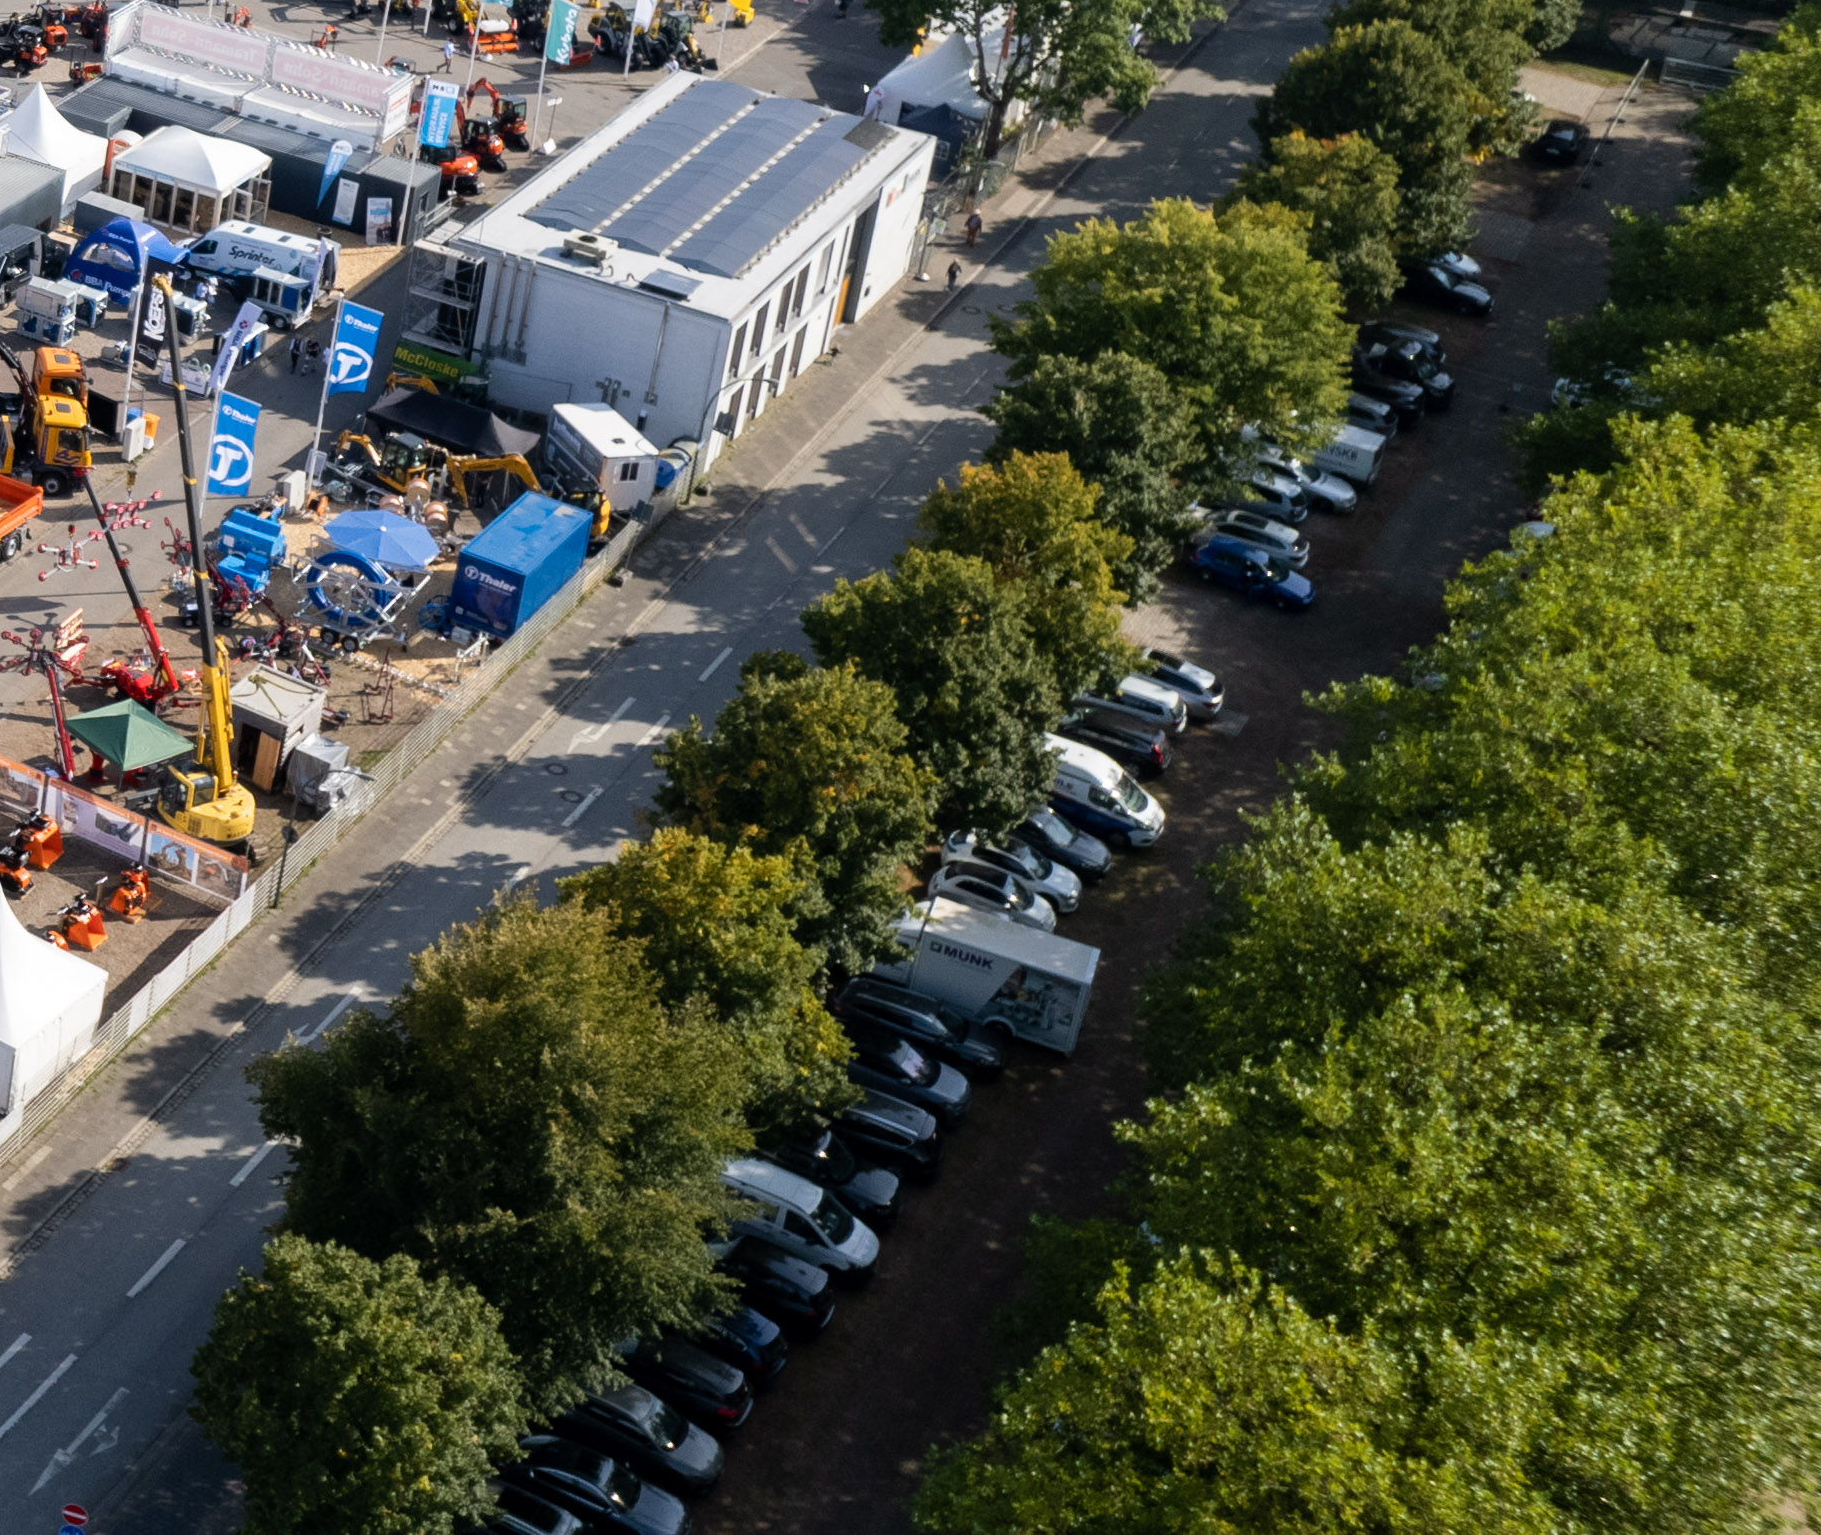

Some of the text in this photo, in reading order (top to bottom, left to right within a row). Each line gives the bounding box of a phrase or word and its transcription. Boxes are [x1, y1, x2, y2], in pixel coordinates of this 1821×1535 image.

[555, 7, 578, 65] Kubota
[228, 245, 276, 266] Sprinter
[353, 316, 379, 333] Thaler
[394, 346, 460, 378] McCloske
[232, 407, 257, 424] Thaler
[478, 571, 518, 592] Thaler
[944, 942, 995, 971] MUNK
